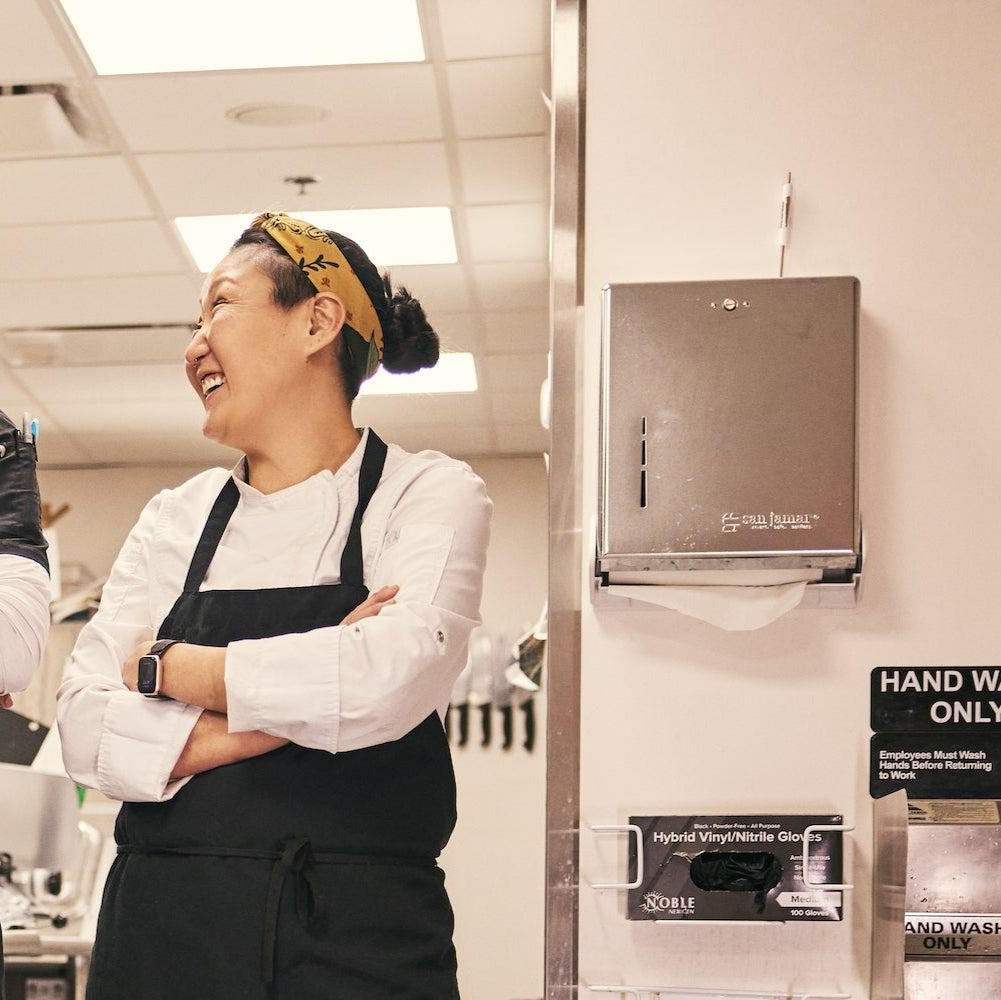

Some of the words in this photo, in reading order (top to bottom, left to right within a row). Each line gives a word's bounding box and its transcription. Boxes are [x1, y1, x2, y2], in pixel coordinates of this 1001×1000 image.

[881, 670, 964, 692] HAND
[971, 670, 1001, 692] W
[880, 751, 932, 760] Employees
[934, 751, 957, 759] Must
[960, 751, 986, 759] Wash
[880, 761, 910, 769] Hands
[912, 761, 943, 769] Before
[945, 761, 992, 771] Returning
[879, 771, 889, 779] to
[891, 771, 916, 779] Work
[653, 832, 695, 844] Hybrid
[699, 831, 774, 844] Vinyl/Nitrile
[646, 897, 695, 909] NOBLE
[923, 937, 971, 949] ONLY
